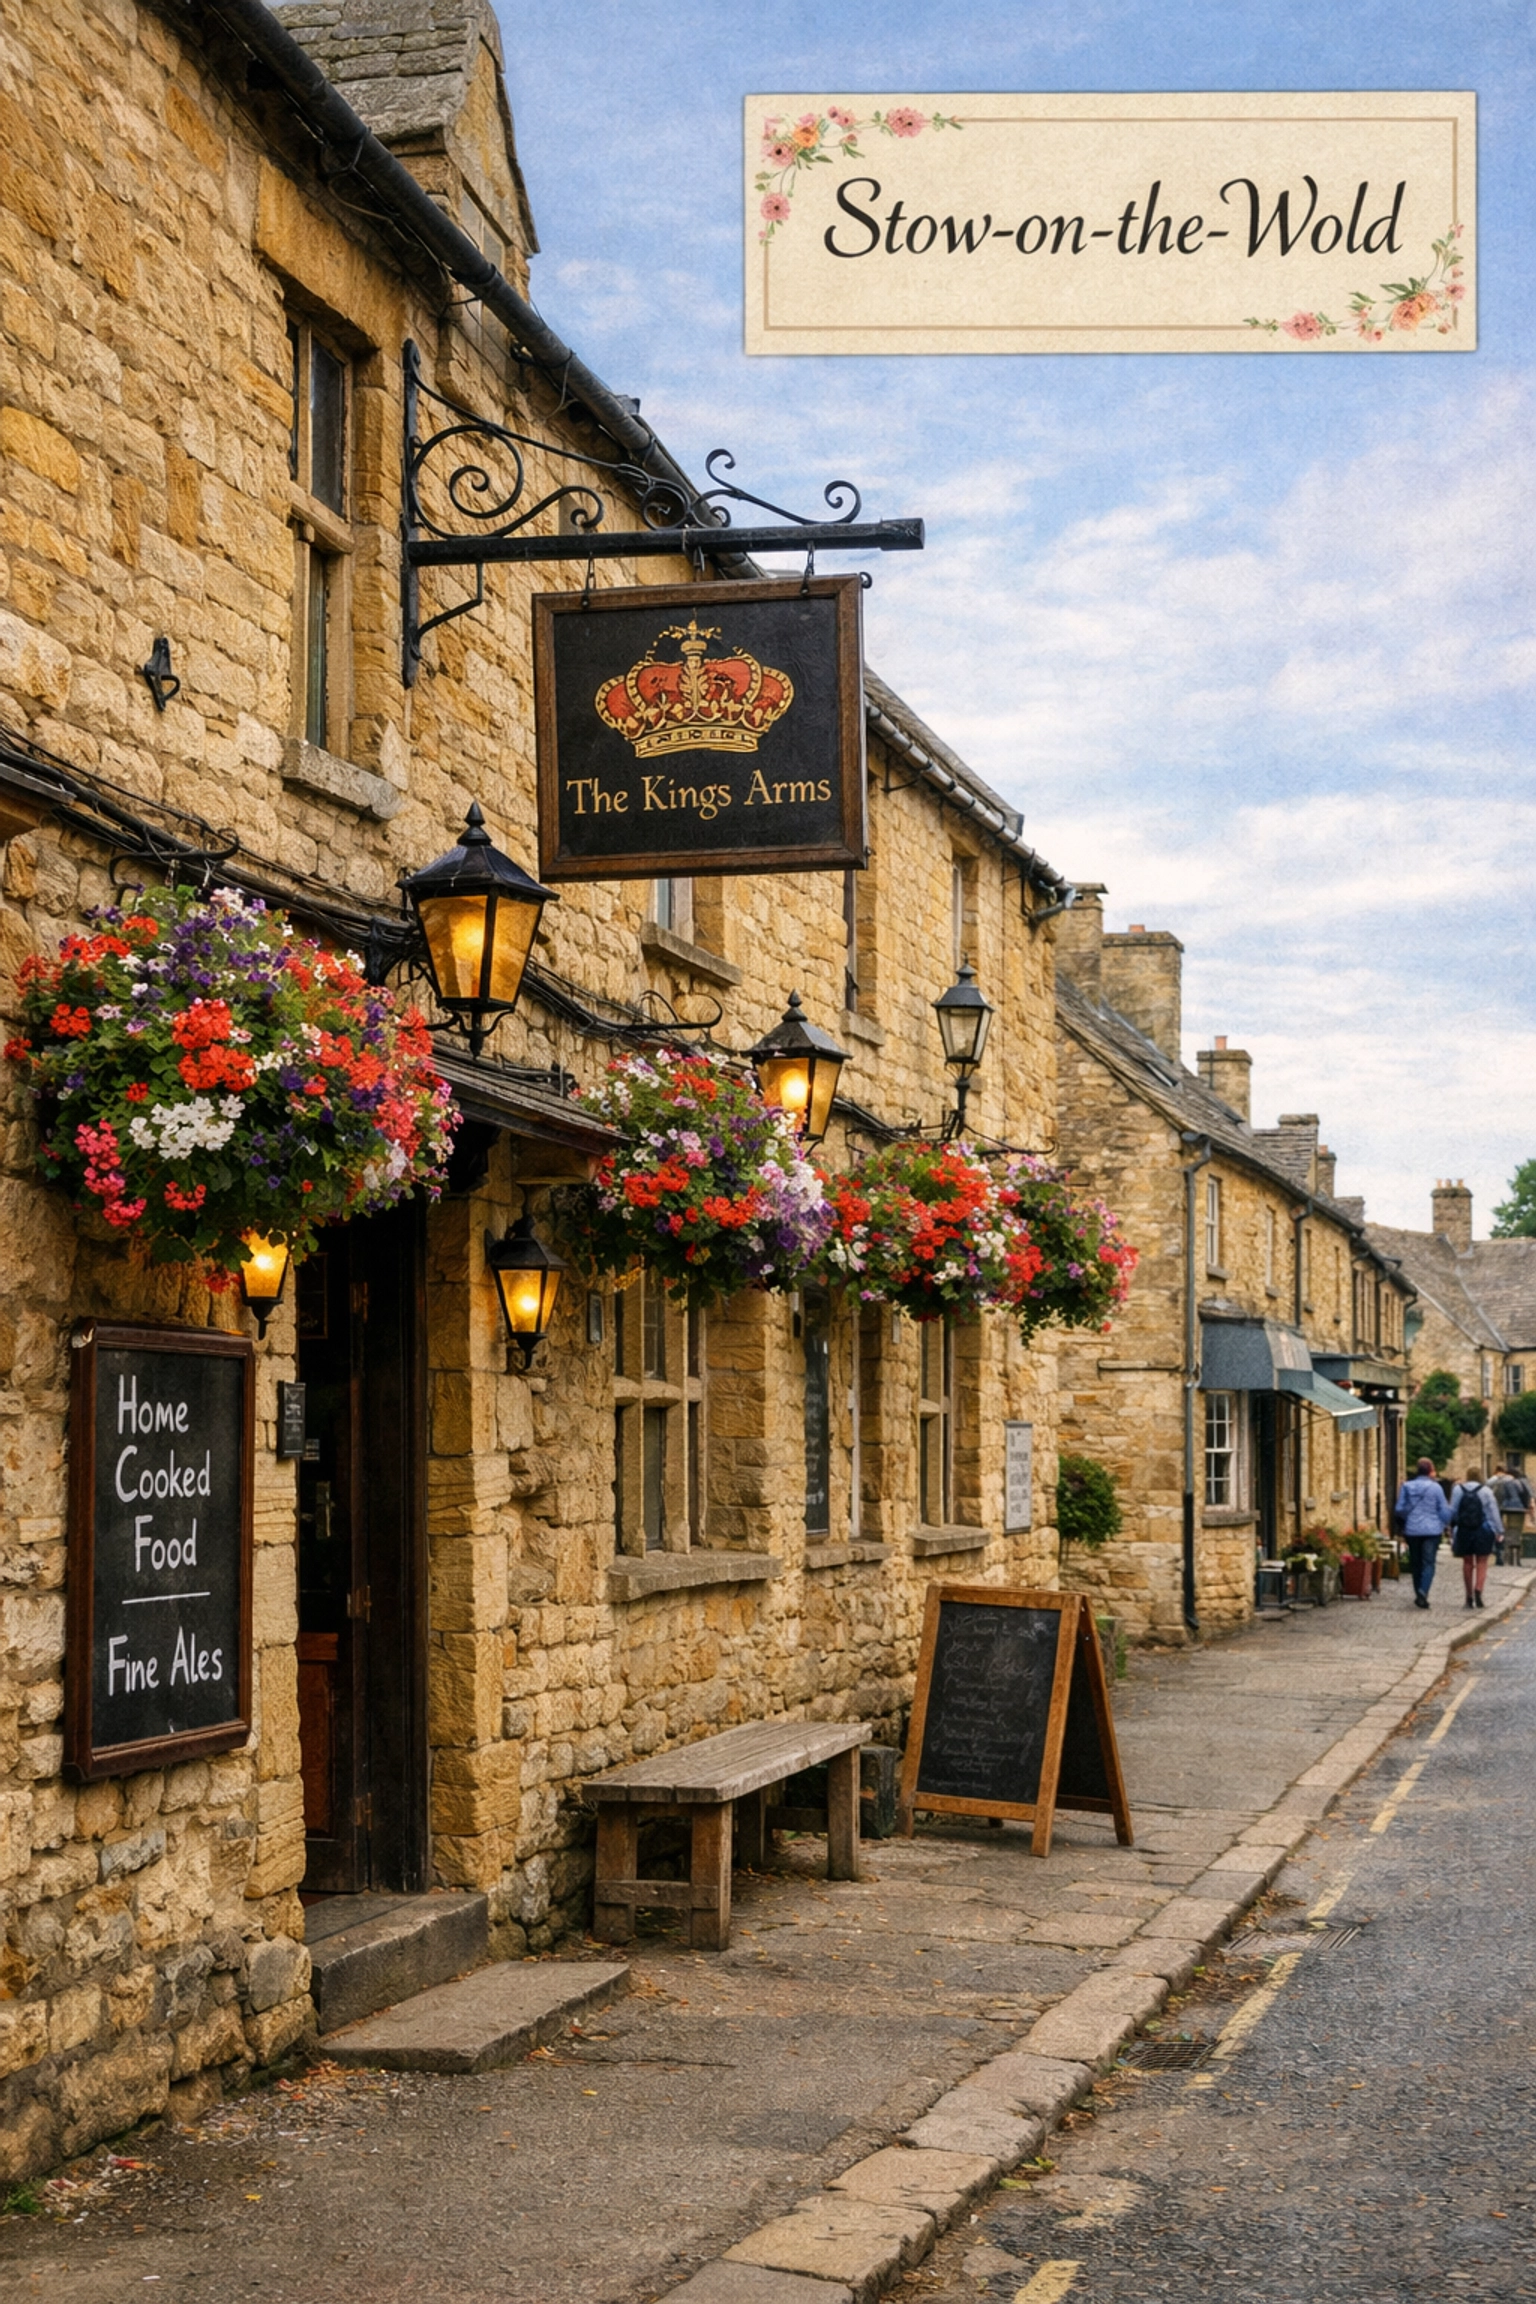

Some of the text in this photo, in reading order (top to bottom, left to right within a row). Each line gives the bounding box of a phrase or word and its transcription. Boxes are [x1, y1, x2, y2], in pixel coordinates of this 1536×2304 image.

[566, 769, 832, 820] The Kings Arms
[118, 1374, 189, 1434] Home
[115, 1445, 211, 1503] Cooked
[135, 1514, 197, 1573] Food
[108, 1626, 223, 1696] Fine Ales
